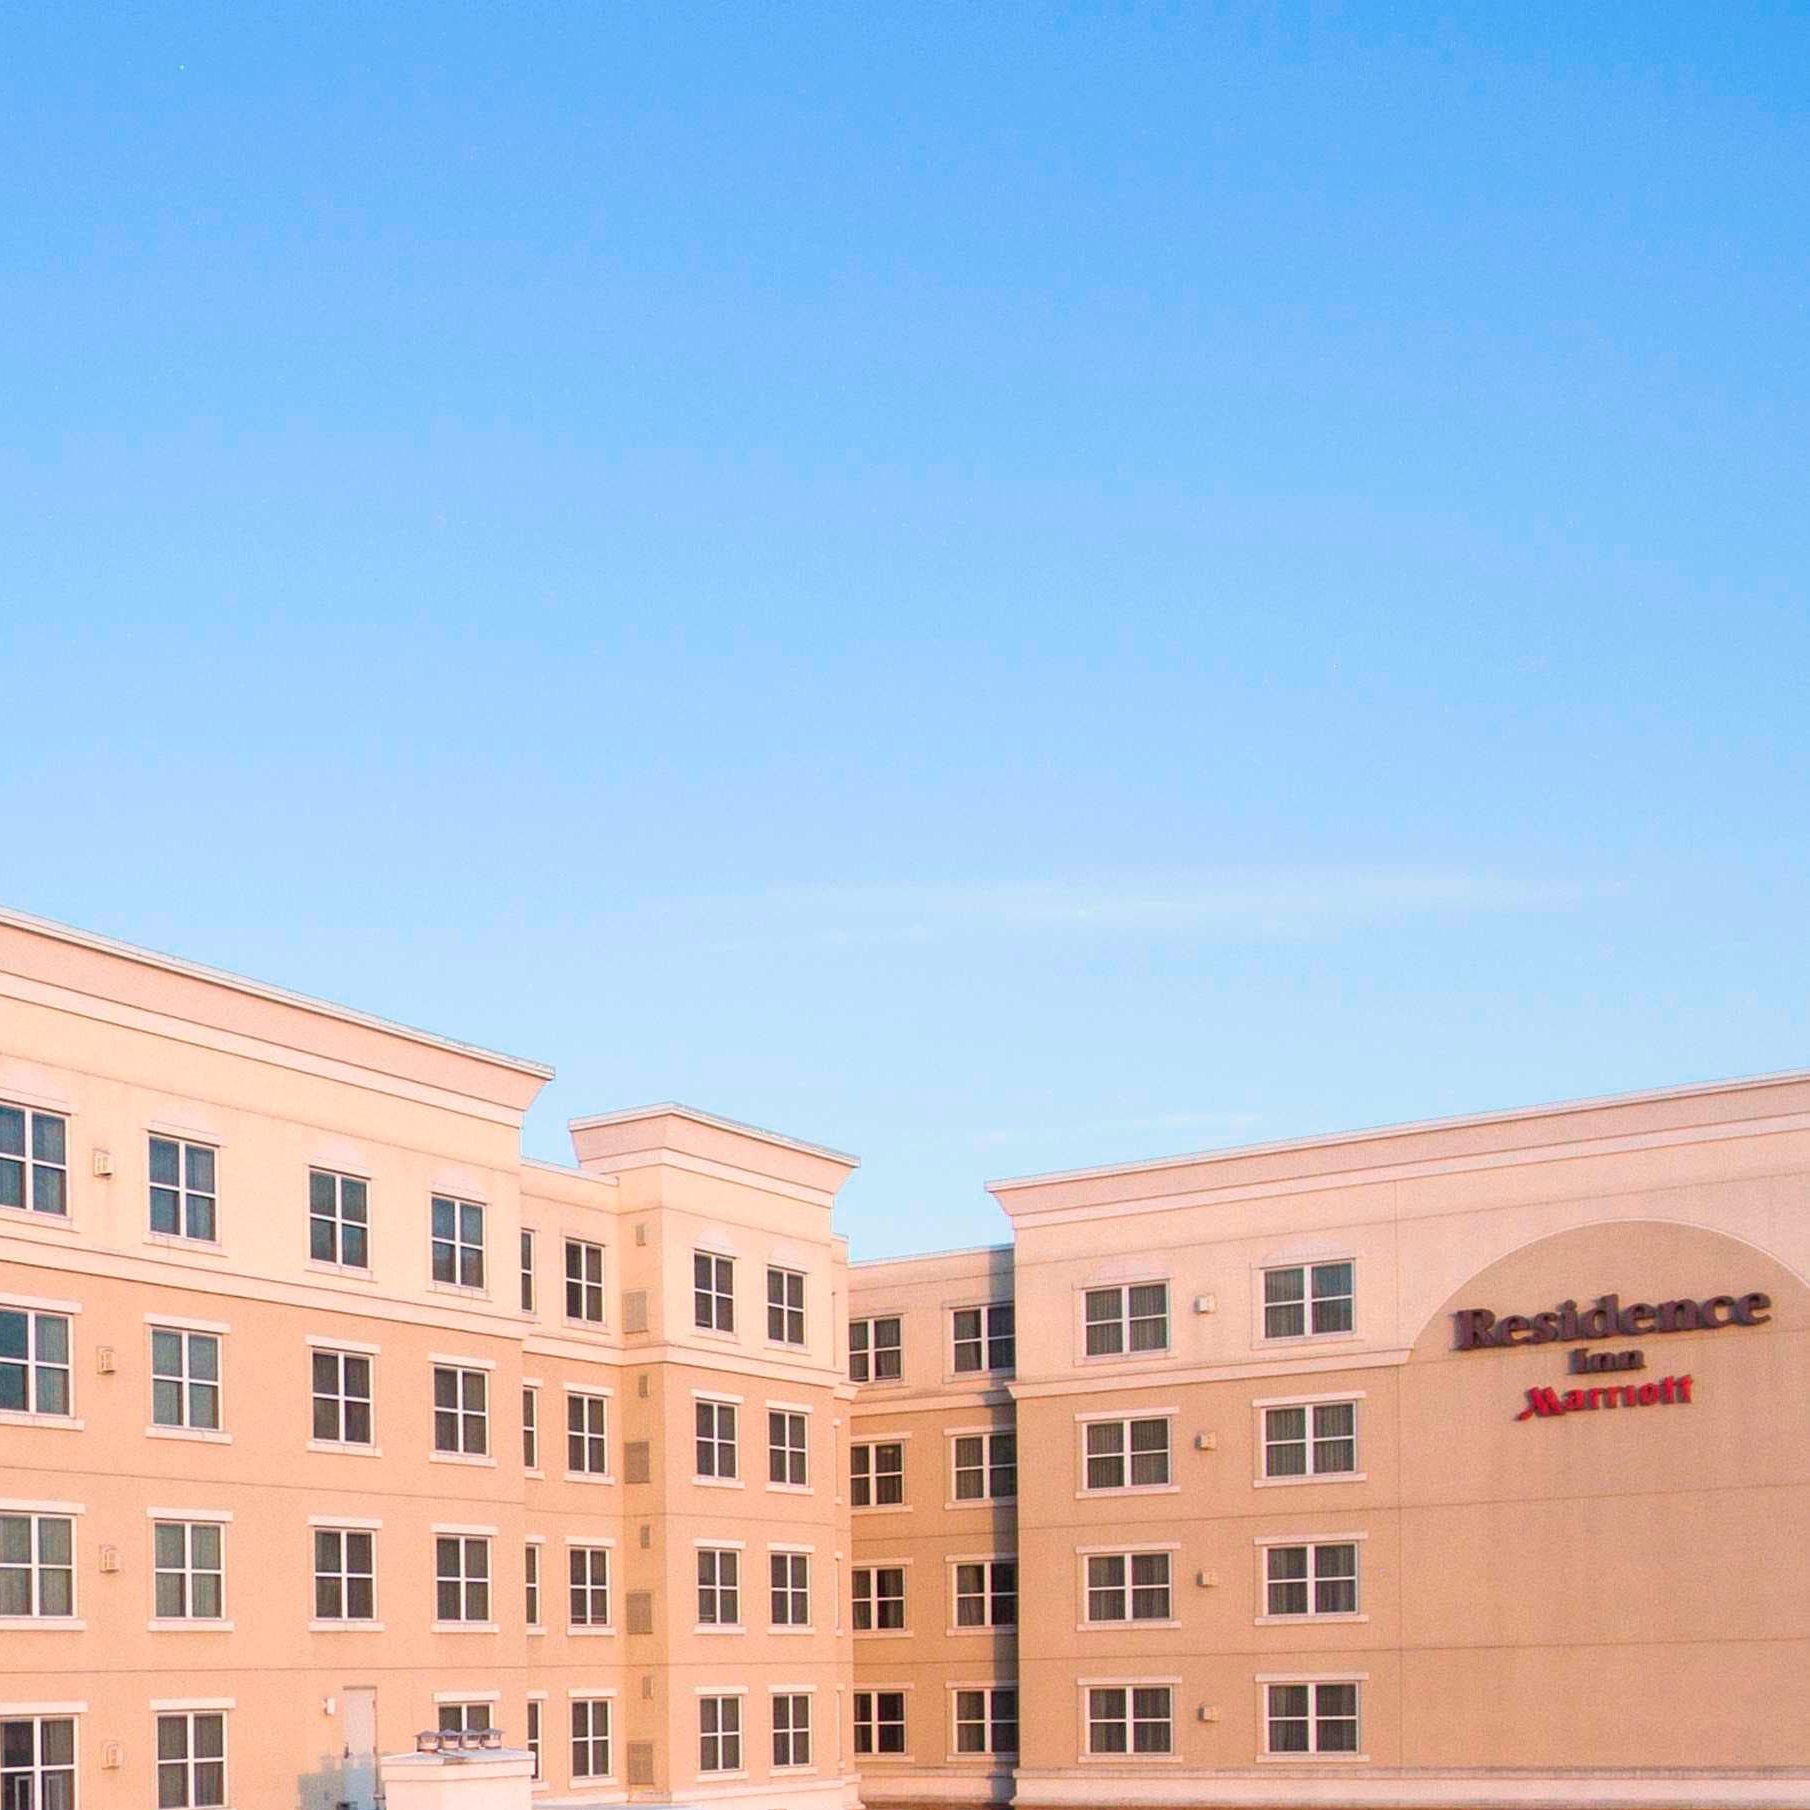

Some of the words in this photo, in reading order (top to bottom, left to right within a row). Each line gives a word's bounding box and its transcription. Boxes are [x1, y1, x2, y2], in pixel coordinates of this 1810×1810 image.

[1450, 1291, 1773, 1351] Residence
[1567, 1347, 1646, 1375] Inn
[1514, 1374, 1694, 1421] Marriott
